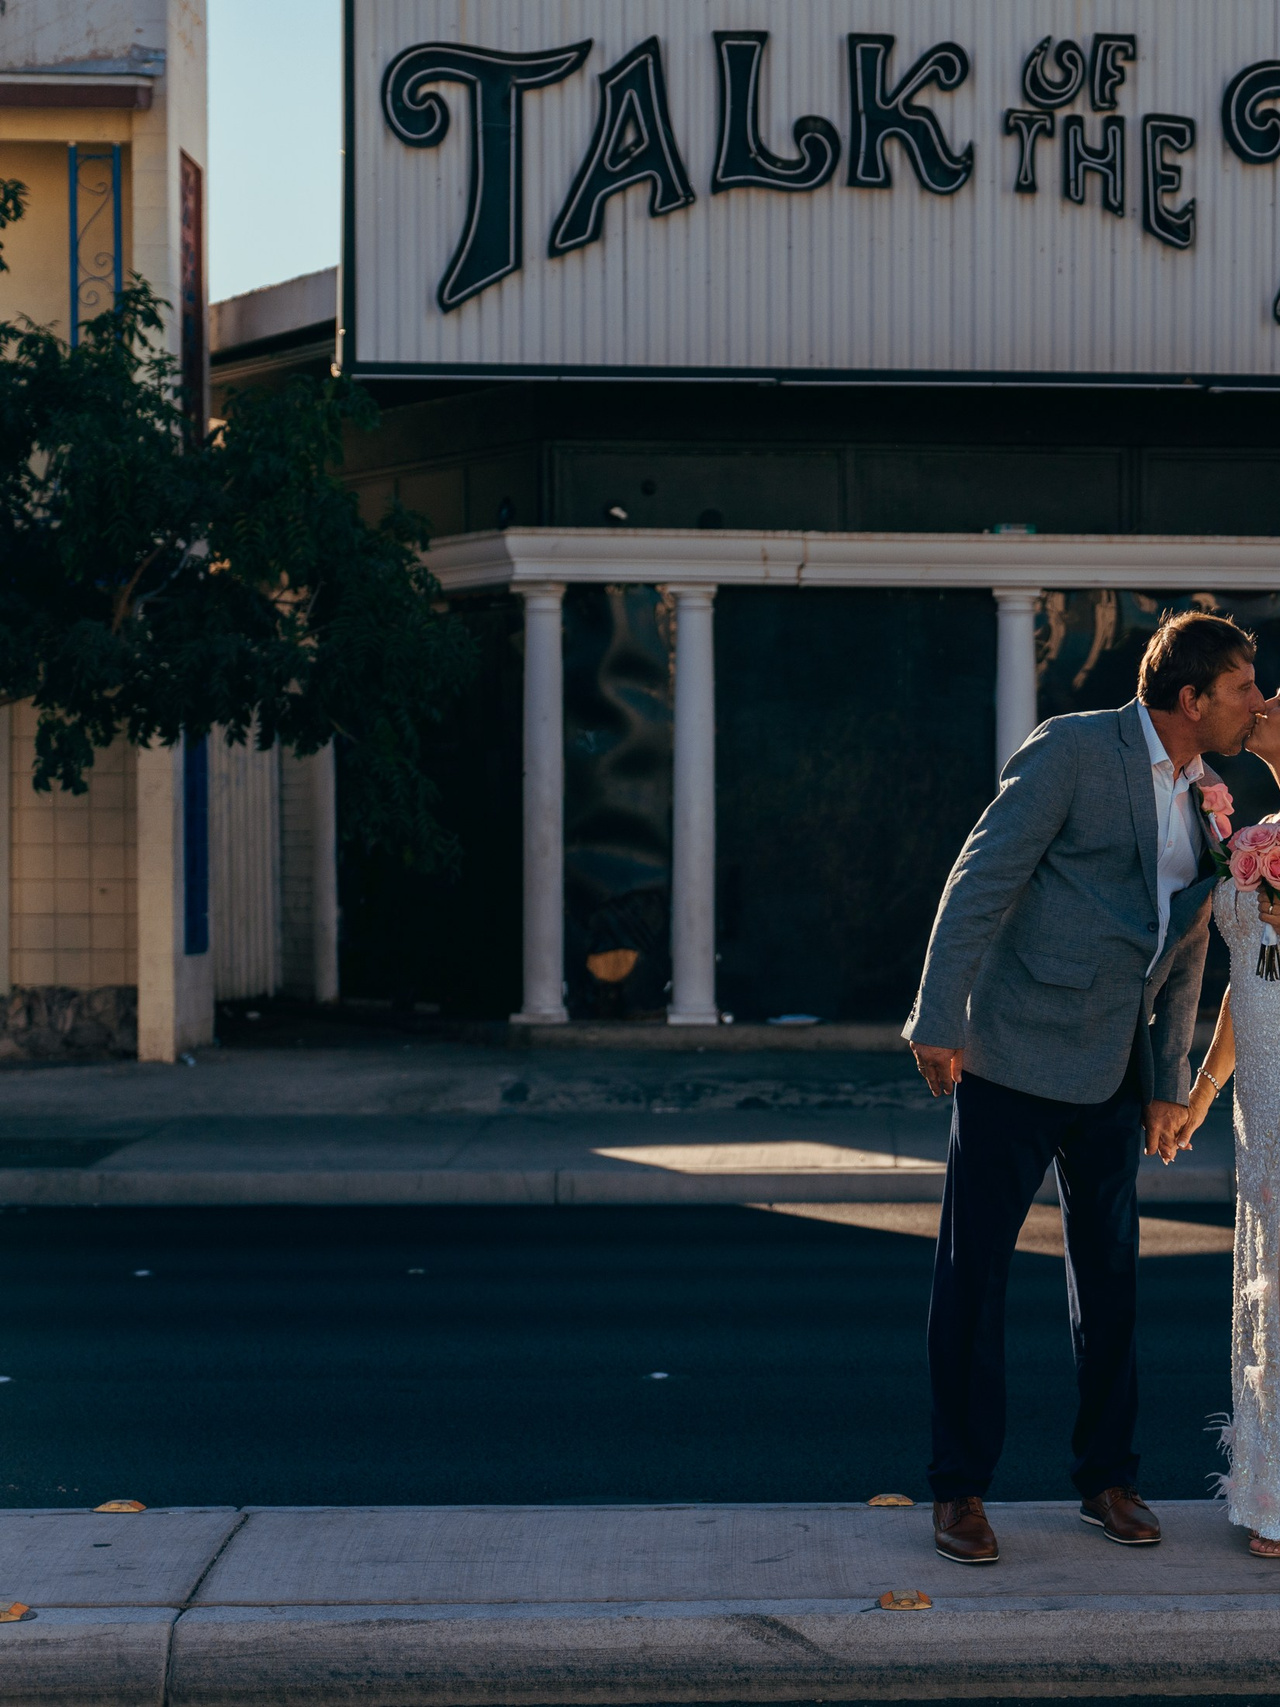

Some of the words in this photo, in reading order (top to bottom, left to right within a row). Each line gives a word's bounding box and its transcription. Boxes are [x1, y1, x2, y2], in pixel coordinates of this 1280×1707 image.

[1022, 33, 1136, 112] OF
[381, 30, 974, 313] TALK
[1005, 107, 1195, 250] THE
